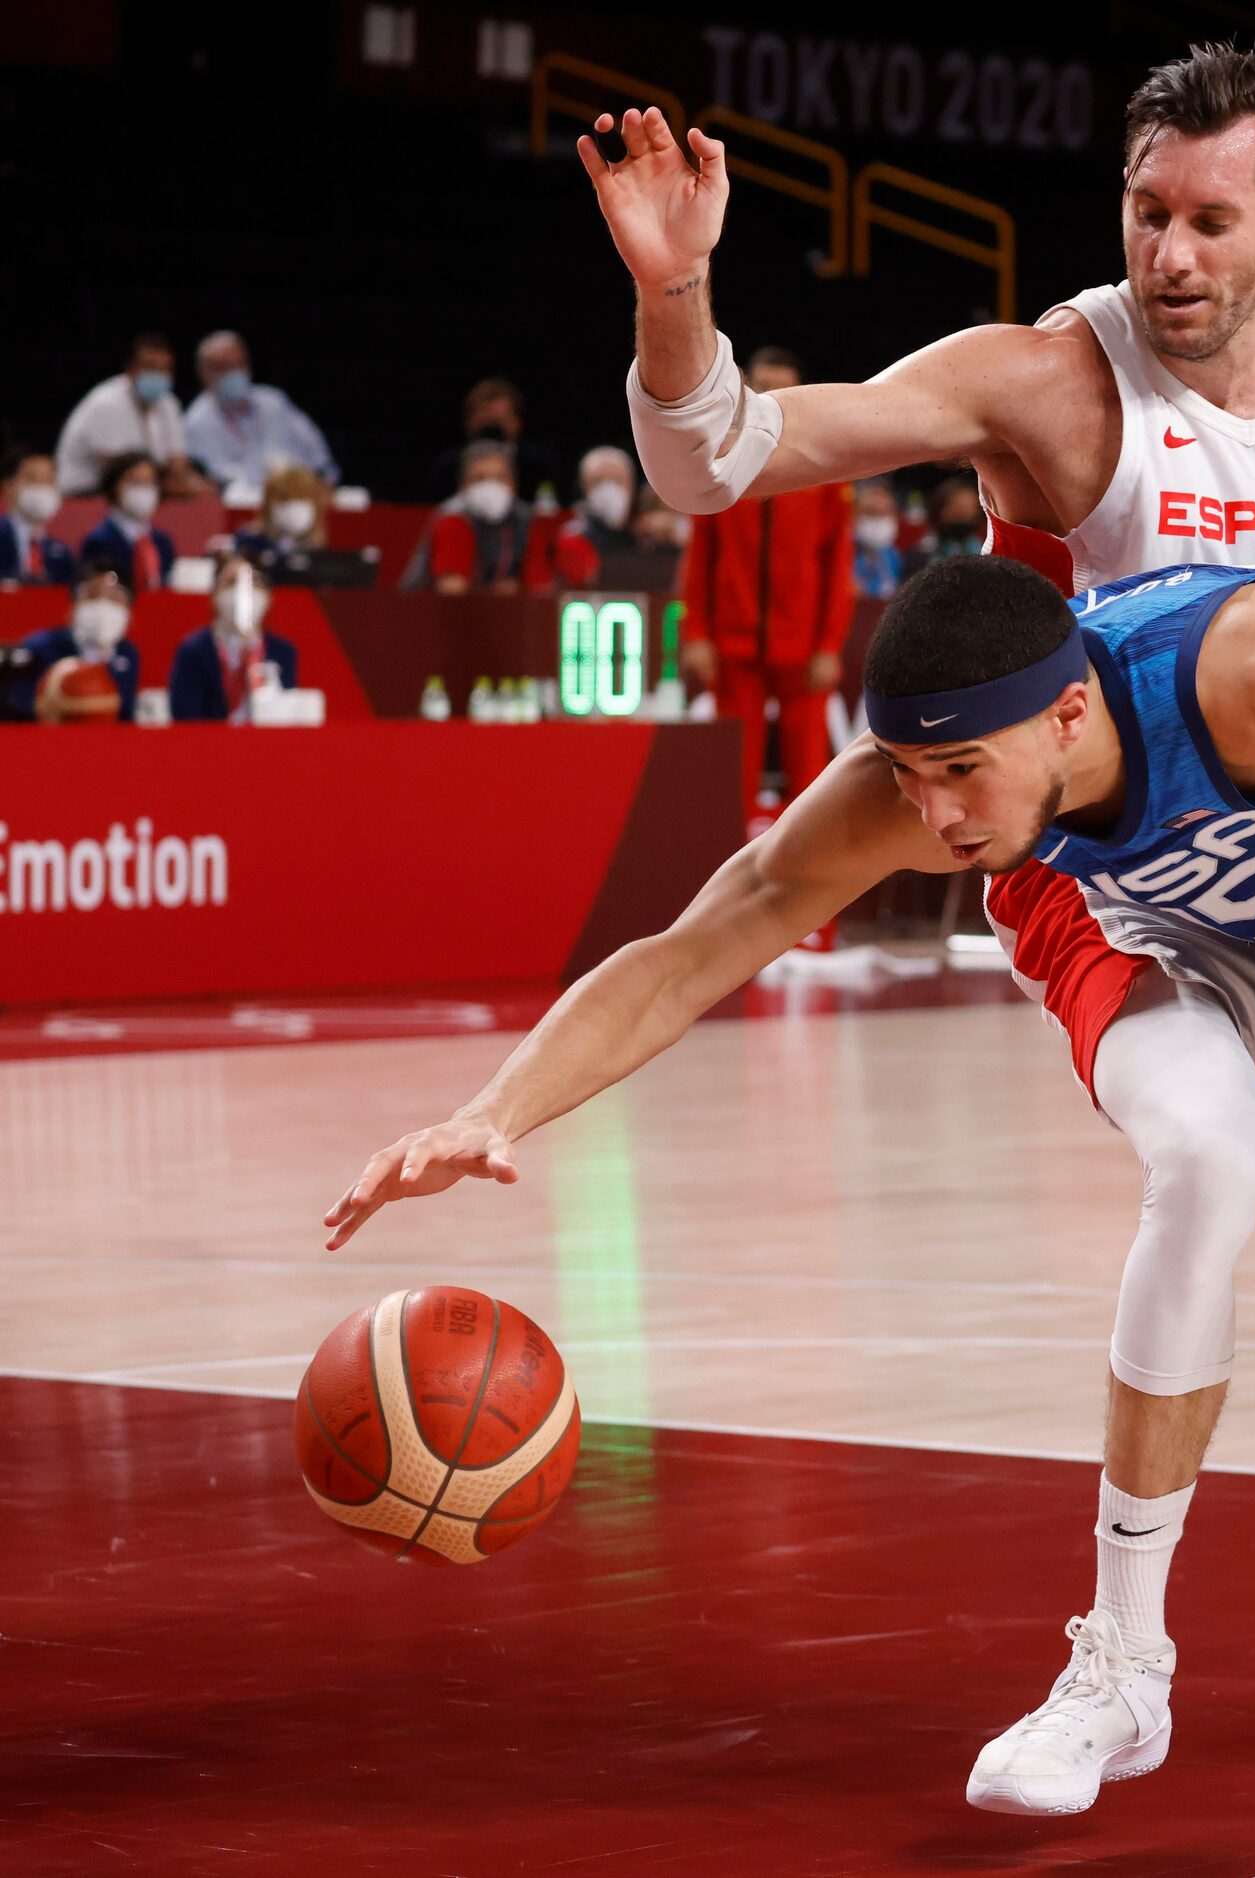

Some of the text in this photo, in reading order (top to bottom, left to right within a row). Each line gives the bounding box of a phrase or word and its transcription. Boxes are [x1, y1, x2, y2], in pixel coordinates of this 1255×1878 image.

[703, 25, 1094, 151] TOKYO 2020
[448, 1298, 478, 1336] FIBA
